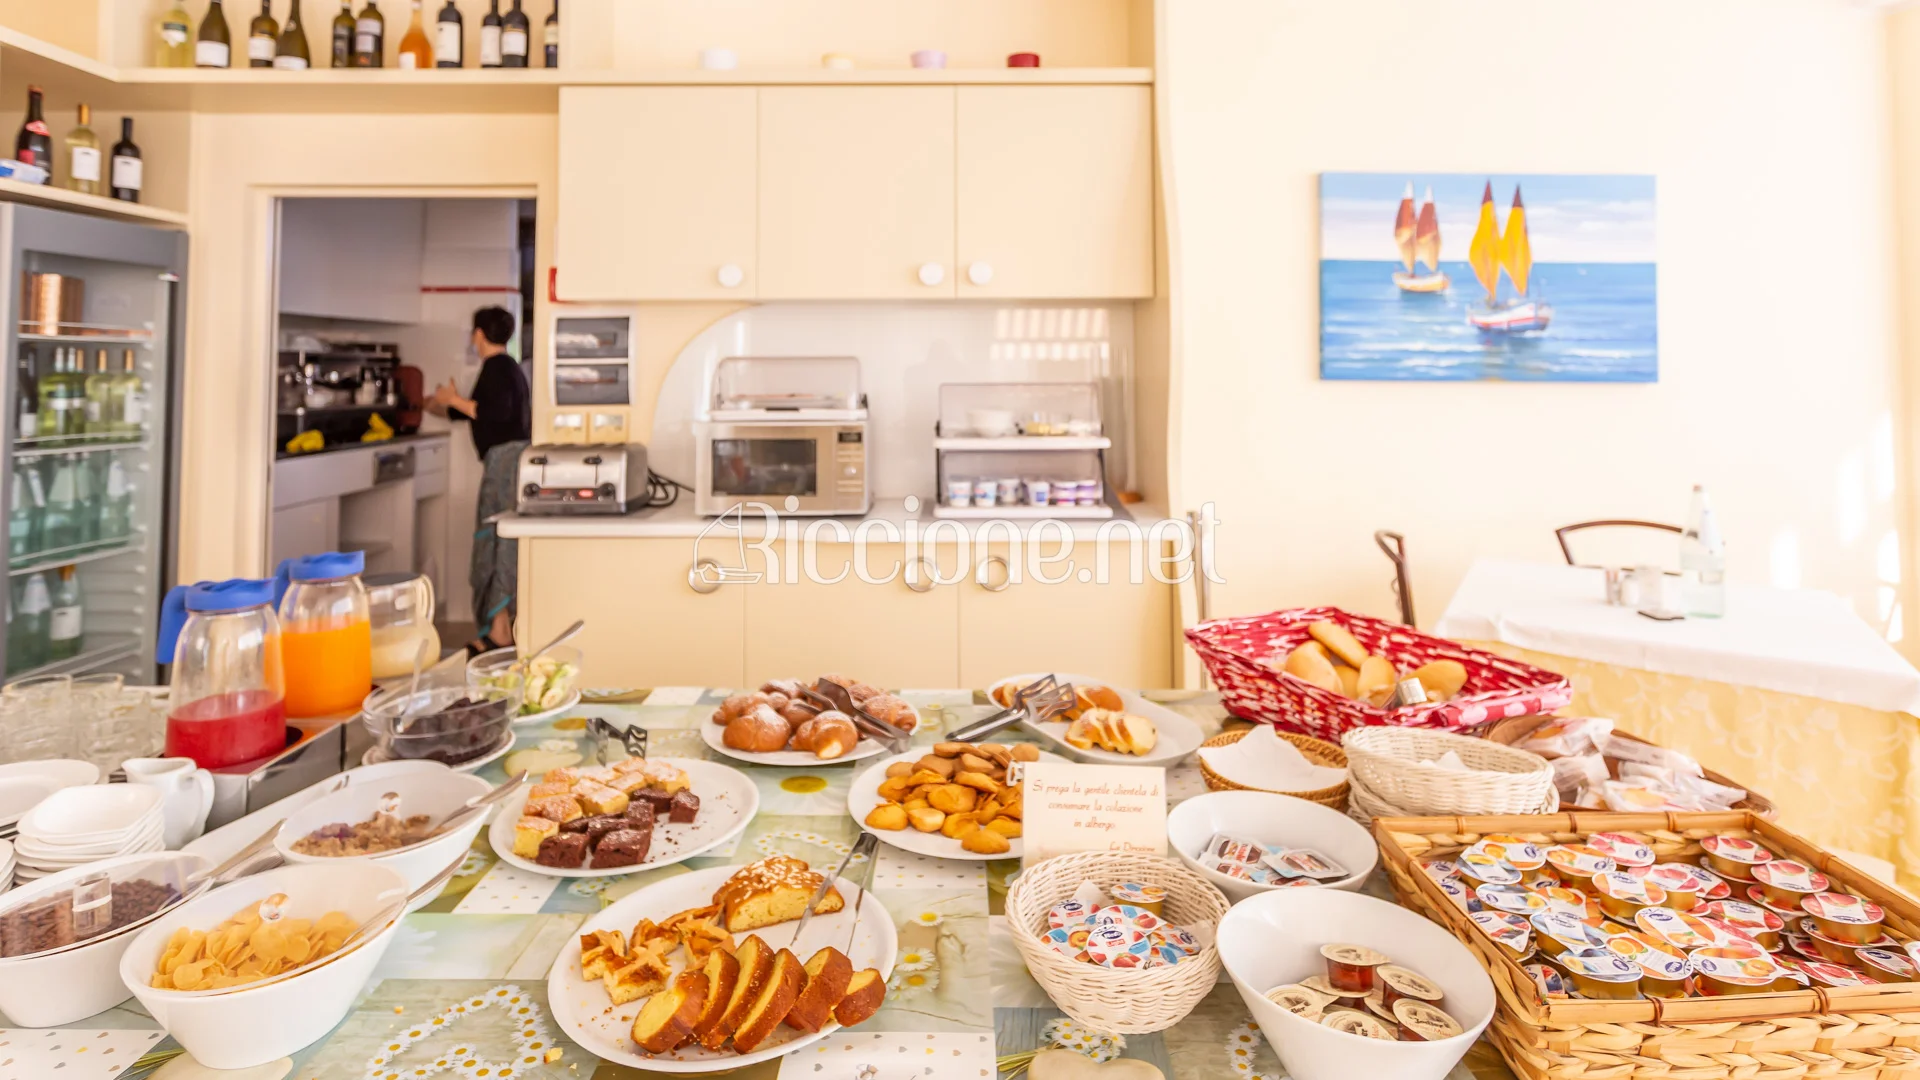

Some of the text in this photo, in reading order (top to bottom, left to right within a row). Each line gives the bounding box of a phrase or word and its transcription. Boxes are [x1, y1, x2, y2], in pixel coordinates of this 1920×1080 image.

[1033, 779, 1159, 797] Si prega la gentile clientela di
[1048, 799, 1143, 813] consumare la colazione
[1074, 816, 1116, 832] in albergo
